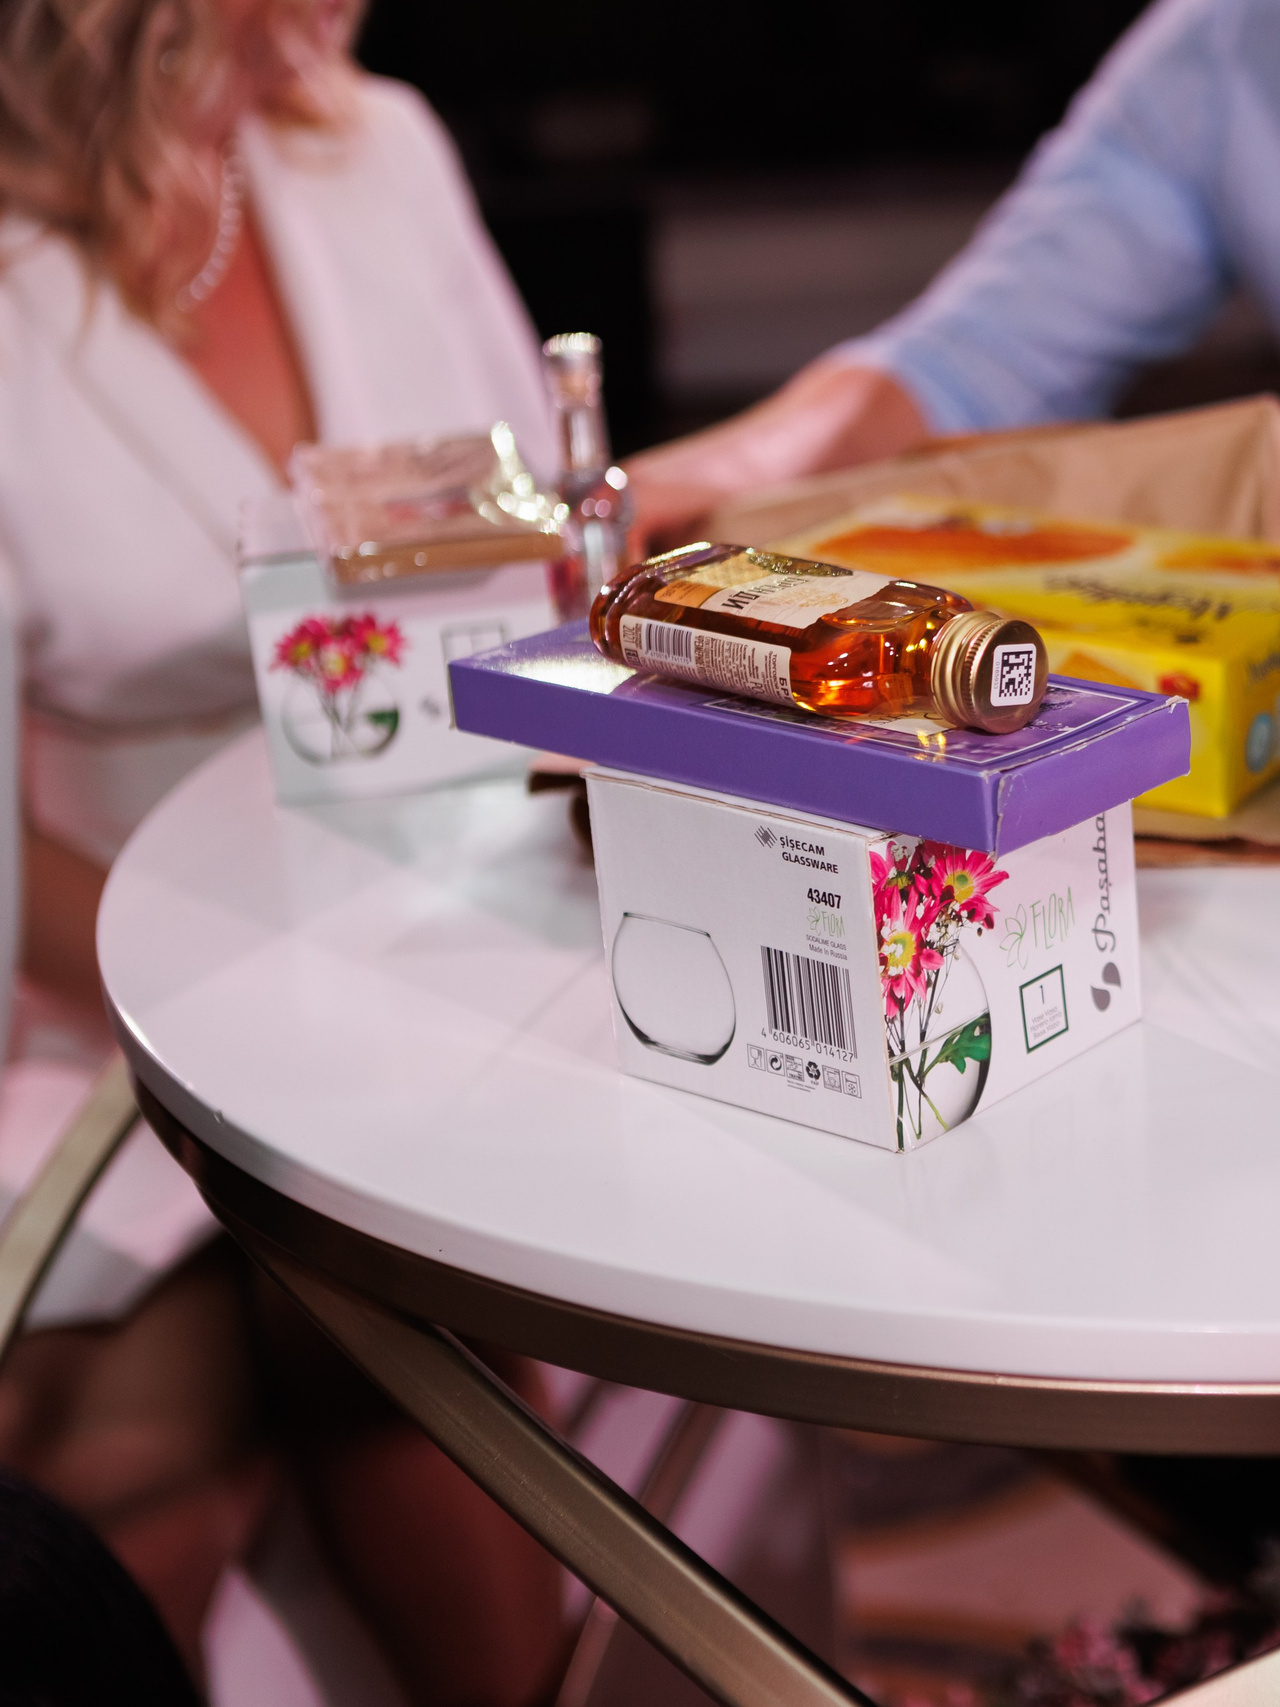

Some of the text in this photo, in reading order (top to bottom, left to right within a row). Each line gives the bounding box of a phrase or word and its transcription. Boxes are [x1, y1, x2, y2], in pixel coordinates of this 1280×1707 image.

[623, 625, 635, 643] 2021
[781, 851, 839, 874] GLASSWARE
[1091, 812, 1117, 953] Paşaba
[807, 887, 842, 909] 43407
[820, 910, 845, 939] FLORA
[1030, 886, 1076, 950] FLORA
[808, 943, 823, 955] Made
[830, 949, 848, 961] Russia
[830, 940, 847, 951] GLASS
[1040, 984, 1045, 1004] 1
[761, 1027, 854, 1063] 4 606065 014127
